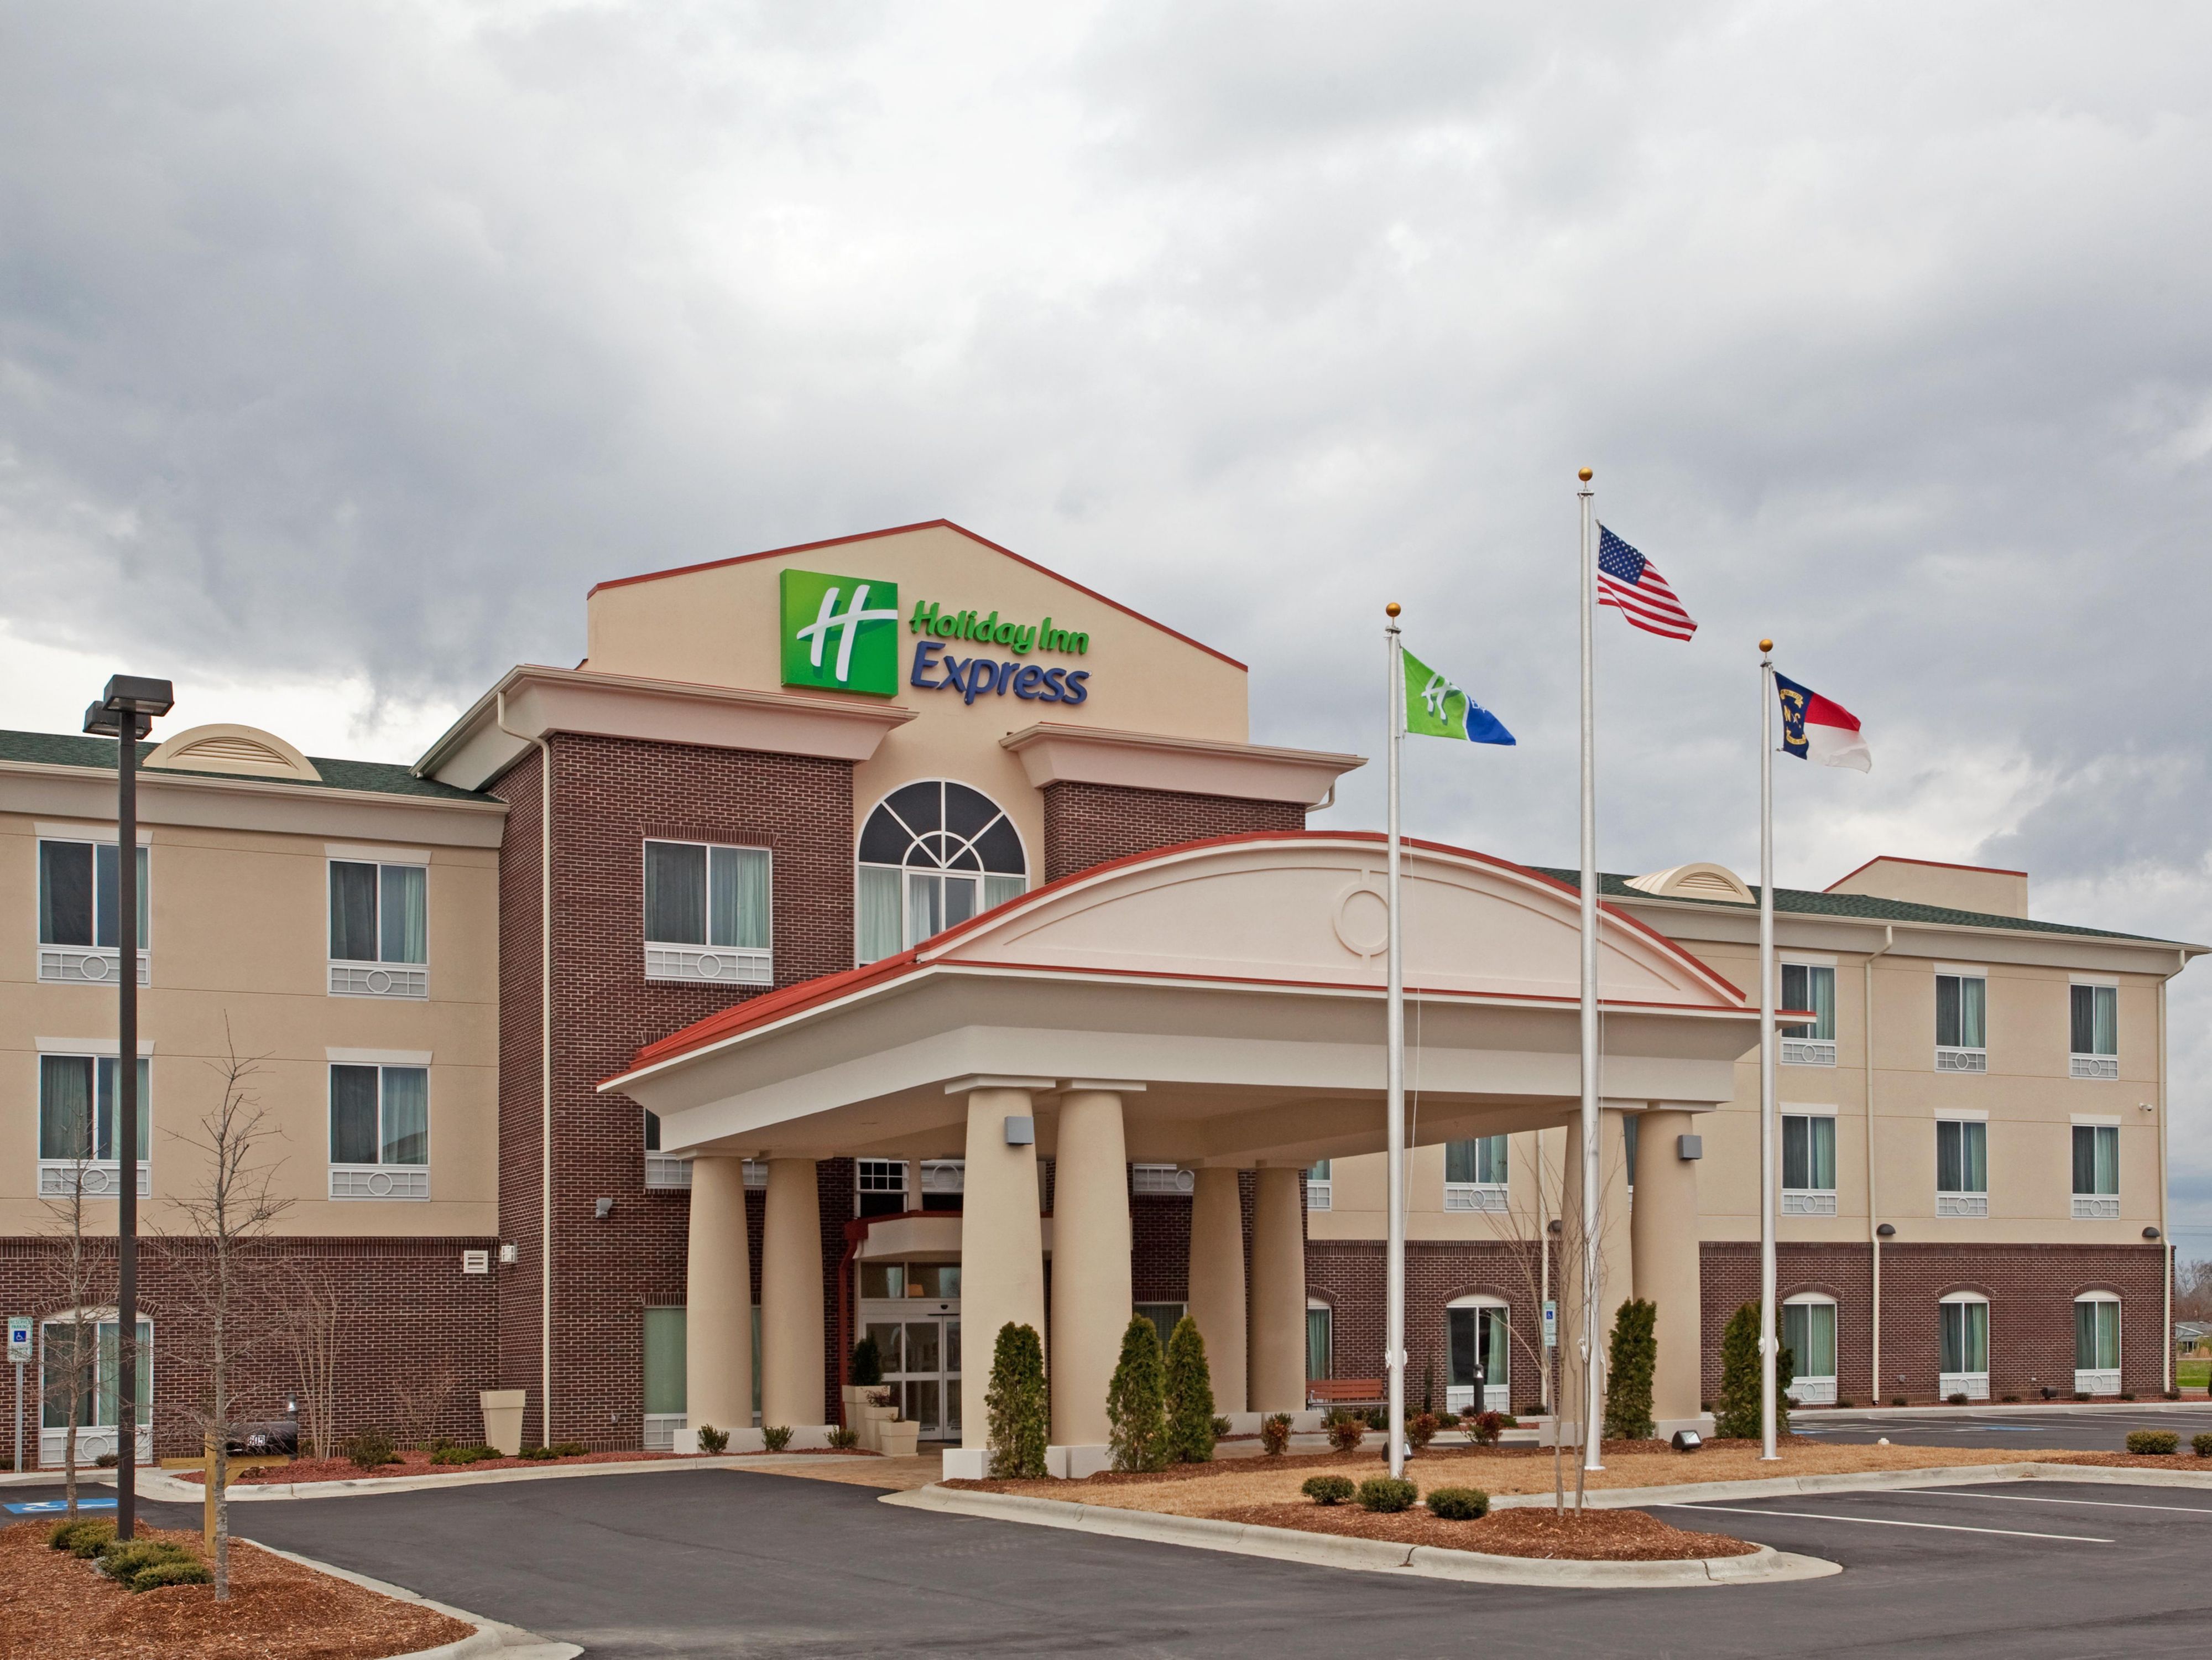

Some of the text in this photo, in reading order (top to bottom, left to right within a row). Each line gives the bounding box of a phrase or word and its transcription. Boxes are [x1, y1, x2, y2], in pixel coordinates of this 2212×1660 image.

[909, 600, 1089, 655] Holiday Inn
[910, 641, 1091, 705] Express
